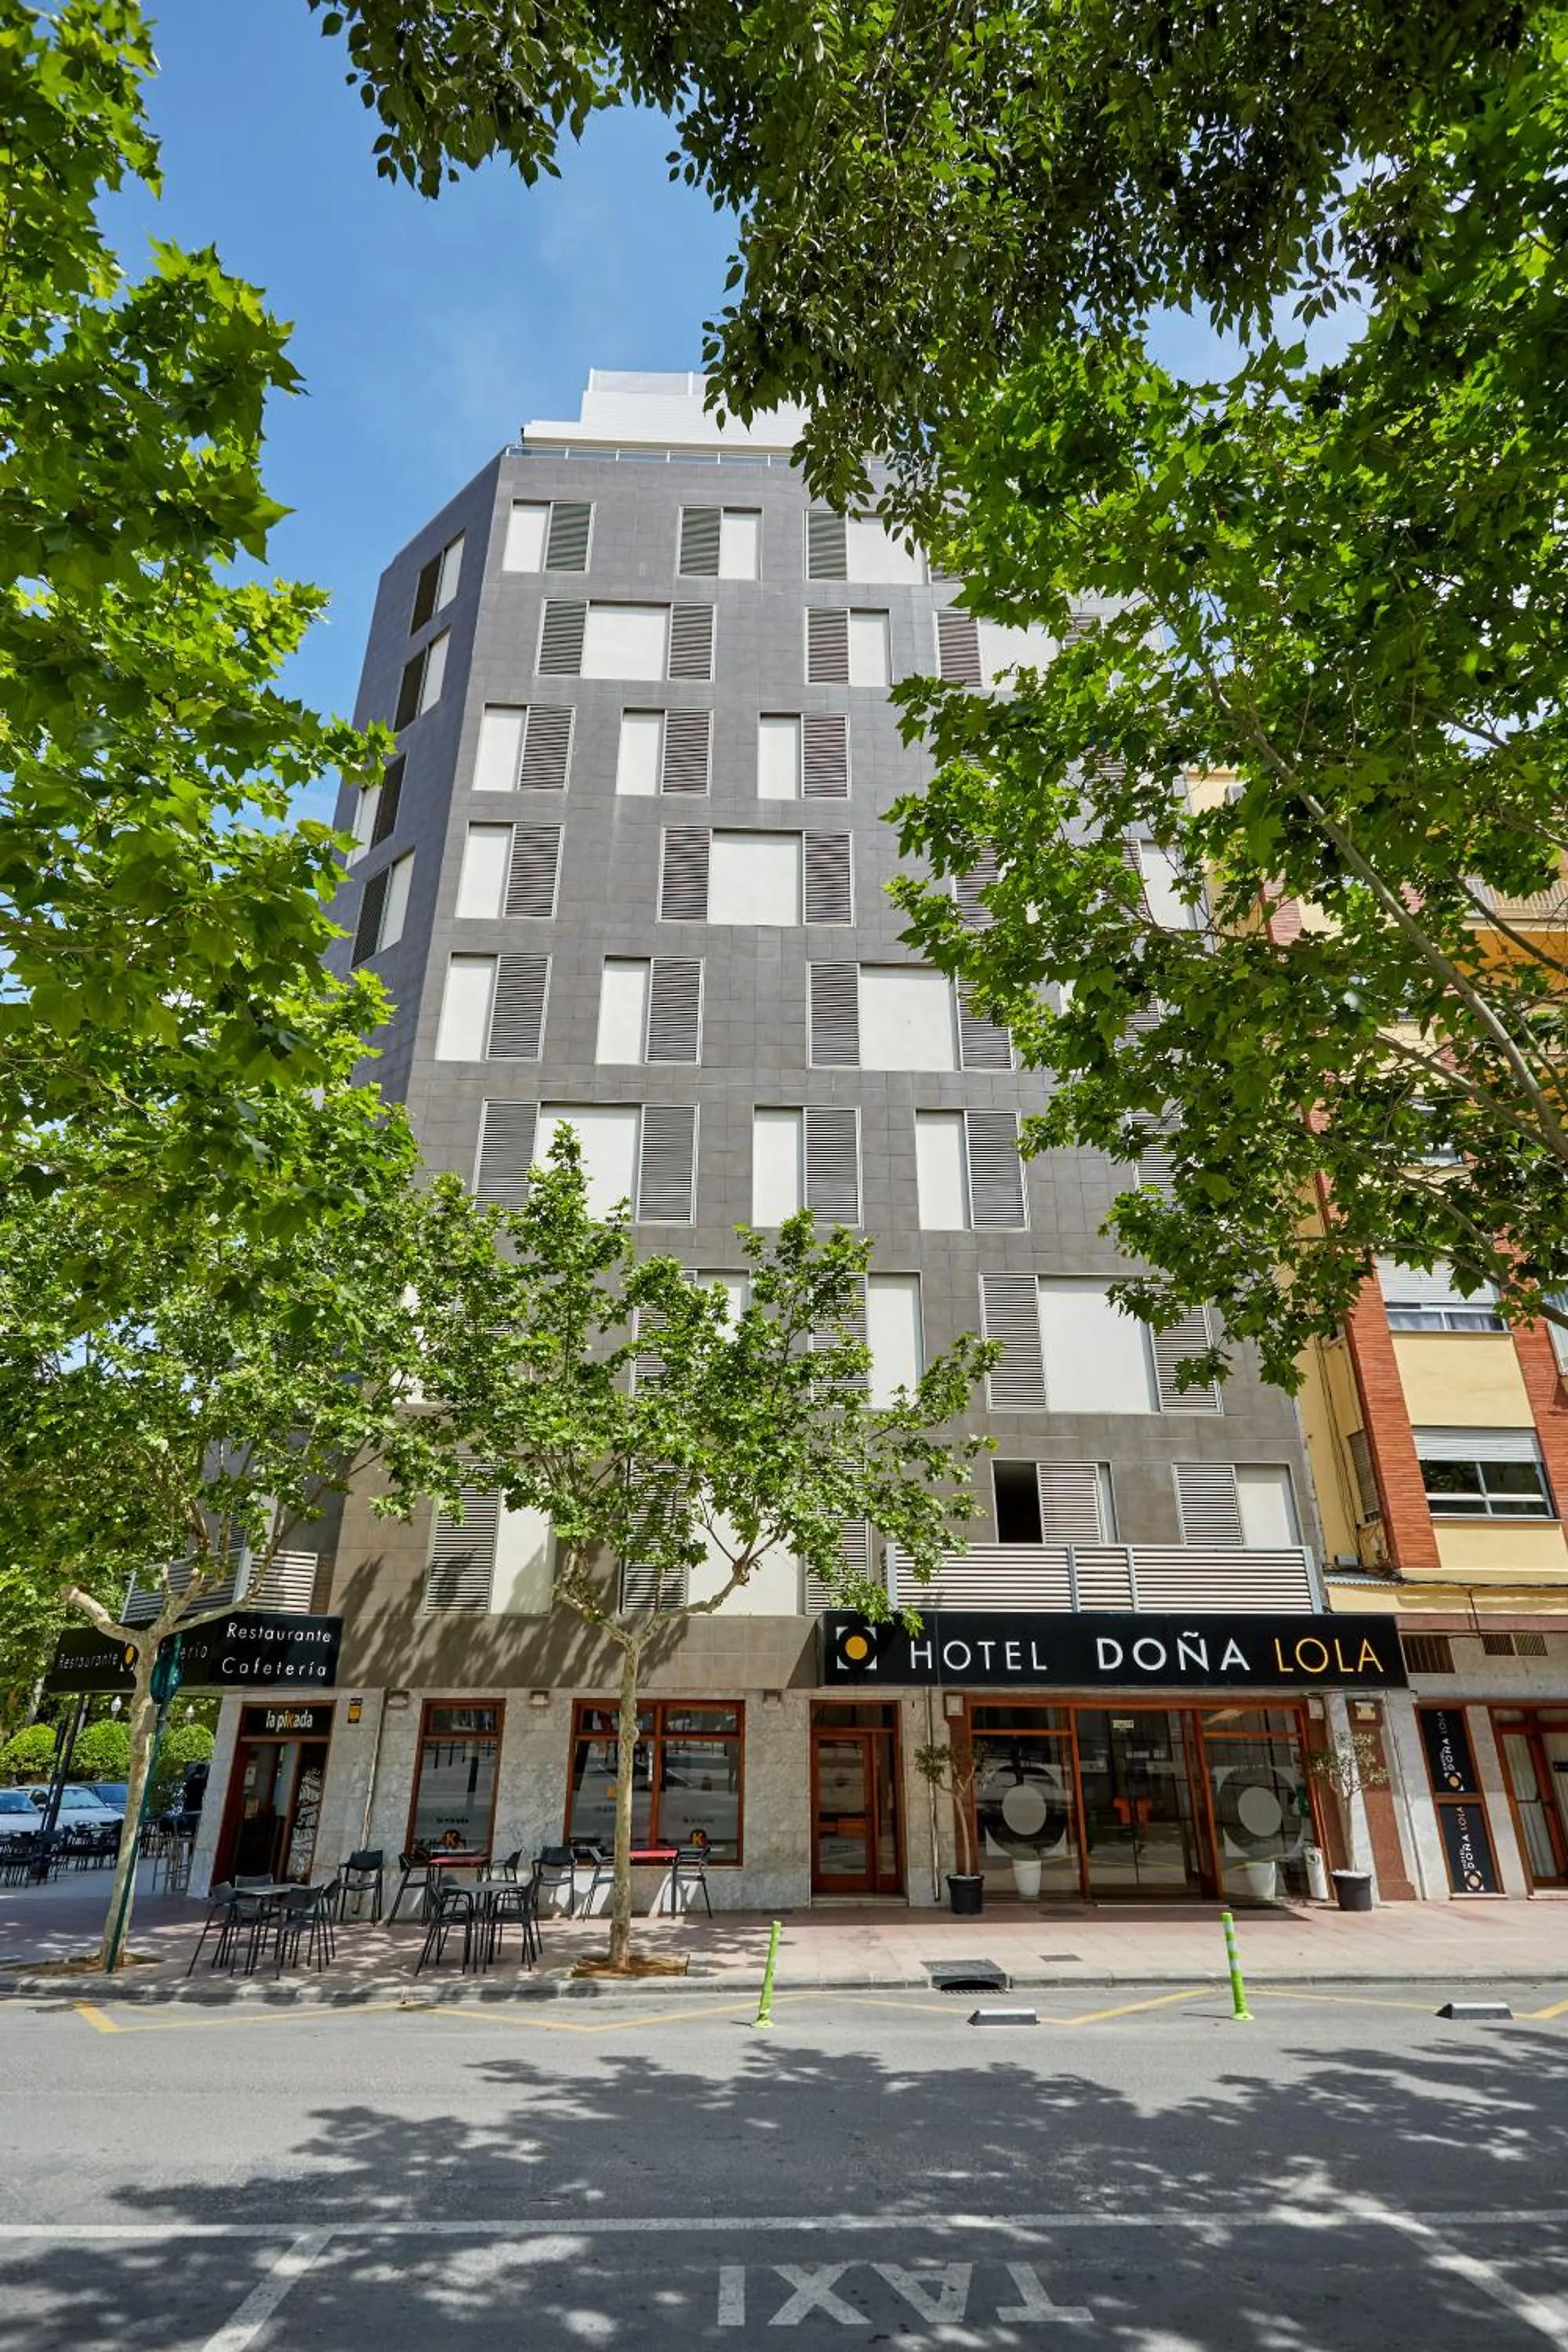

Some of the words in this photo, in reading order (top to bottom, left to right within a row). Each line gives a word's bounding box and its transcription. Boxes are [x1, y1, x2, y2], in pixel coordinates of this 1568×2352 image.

[226, 1622, 332, 1642] Restaurante
[909, 1639, 1048, 1671] HOTEL
[1095, 1631, 1251, 1672] DOÑA
[1274, 1638, 1385, 1672] LOLA
[221, 1656, 328, 1677] Cafetería
[266, 1709, 276, 1729] la
[717, 2260, 1095, 2326] TAXI
